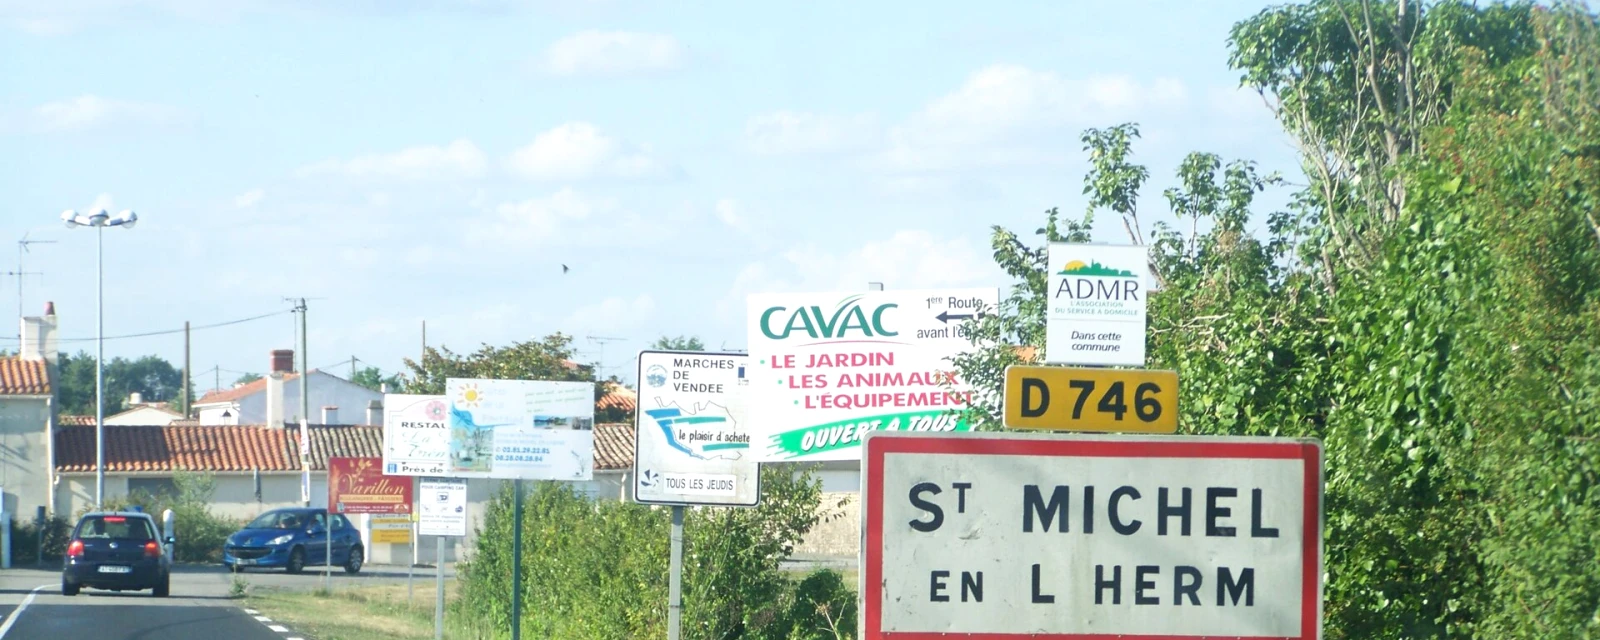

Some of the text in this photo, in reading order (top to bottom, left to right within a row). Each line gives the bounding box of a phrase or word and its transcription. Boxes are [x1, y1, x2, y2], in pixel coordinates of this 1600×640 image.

[1056, 278, 1139, 301] ADMR
[948, 296, 983, 309] Route
[1070, 300, 1124, 308] L'ASSOCIATION
[1104, 308, 1138, 316] DOMICILE
[760, 301, 899, 340] CAVAC
[916, 327, 949, 339] avant
[1071, 330, 1122, 341] Dans cette
[1072, 343, 1121, 352] commune
[673, 358, 735, 369] MARCHES
[771, 352, 894, 369] LE JARDIN
[673, 371, 689, 380] DE
[788, 371, 959, 389] LES ANIMAUX
[673, 383, 724, 393] VENDEE
[805, 391, 975, 410] L'ÉQUIPEMENT
[1020, 377, 1162, 422] D 746
[679, 429, 686, 440] le
[689, 430, 714, 443] plaisir
[802, 419, 882, 452] OUVERT
[907, 414, 960, 432] TOUS
[666, 478, 734, 491] TOUS LES JEUDIS
[1022, 484, 1280, 539] MICHEL
[930, 563, 1256, 607] EN L HERM
